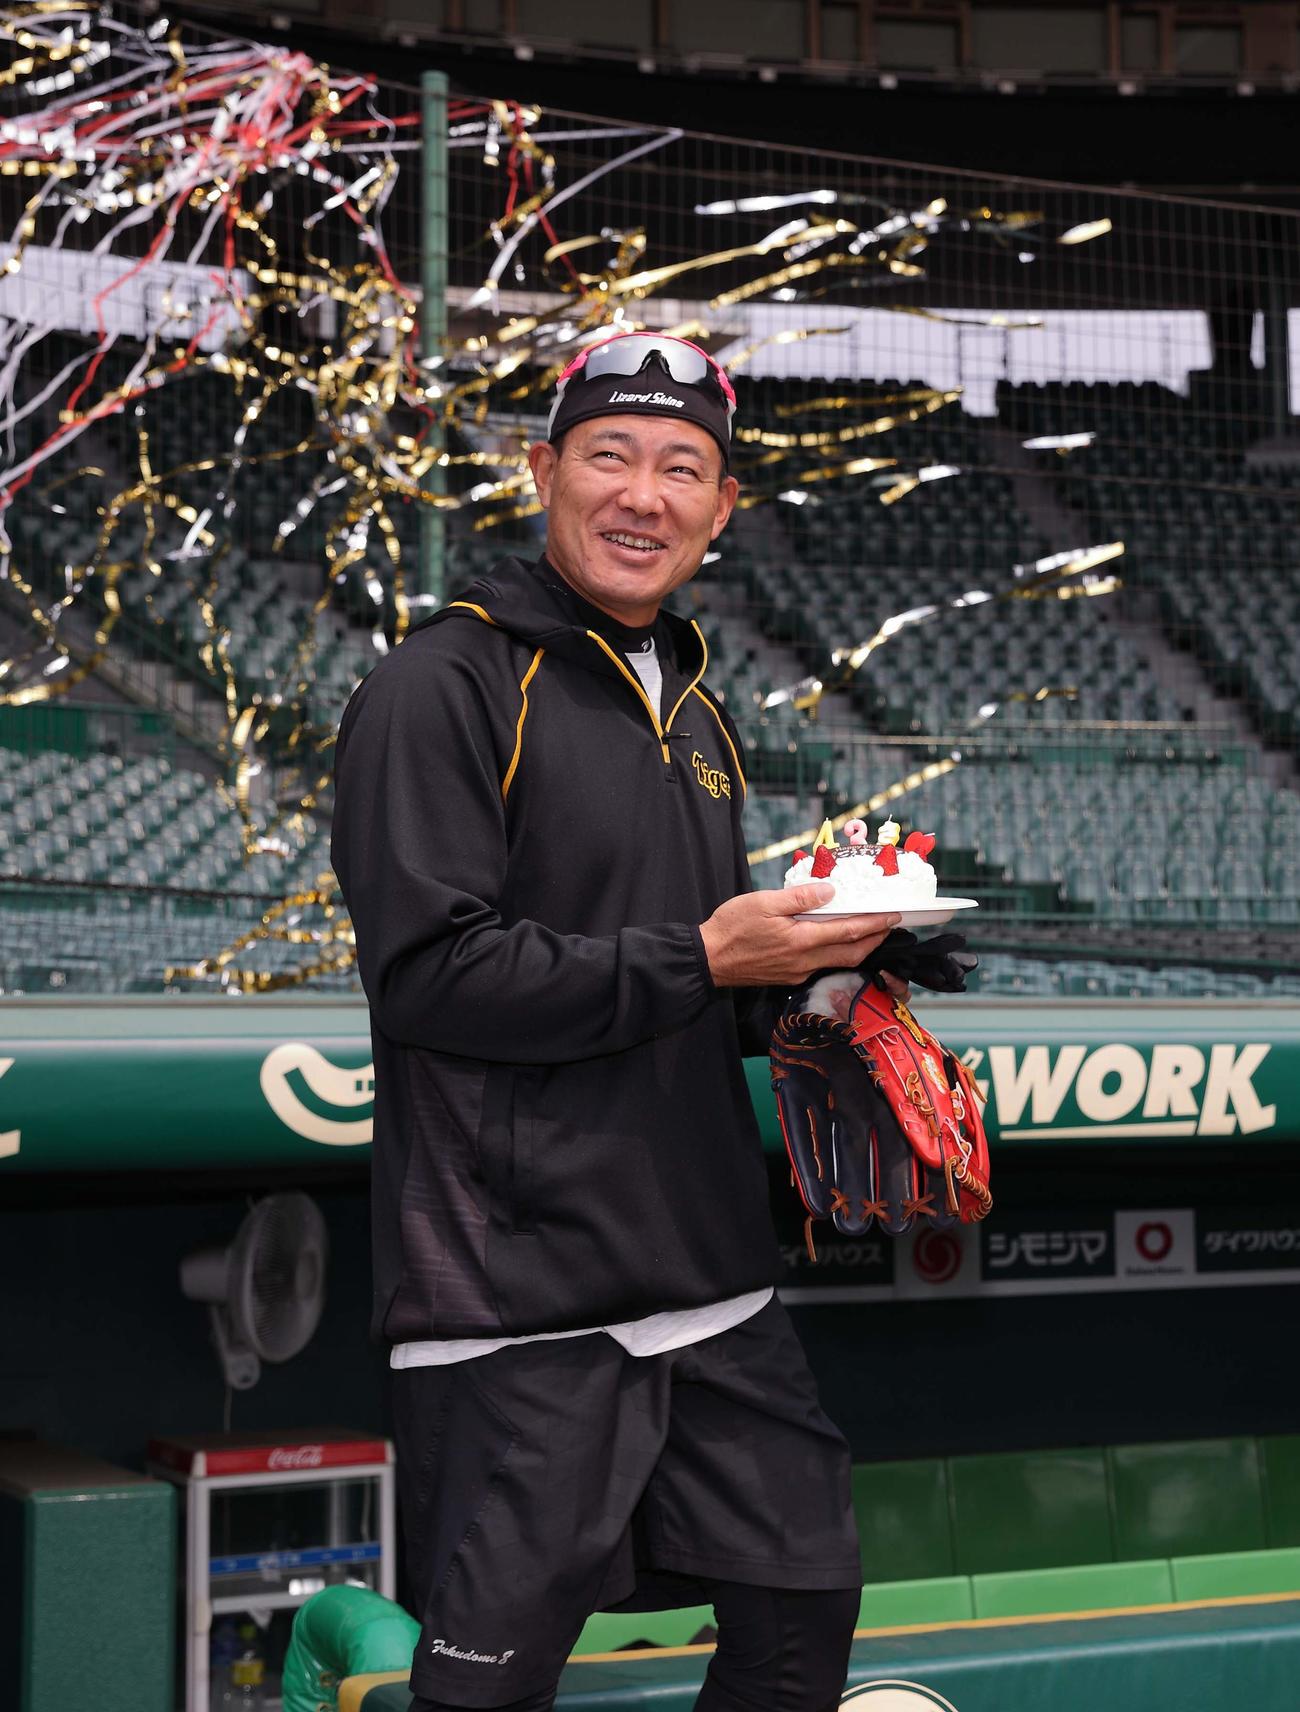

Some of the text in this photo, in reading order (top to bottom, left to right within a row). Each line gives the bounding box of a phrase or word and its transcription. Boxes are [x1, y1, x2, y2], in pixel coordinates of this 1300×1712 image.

[608, 391, 685, 408] Lizard Skins
[691, 751, 731, 800] Tige
[431, 1639, 515, 1665] Fukudome 8
